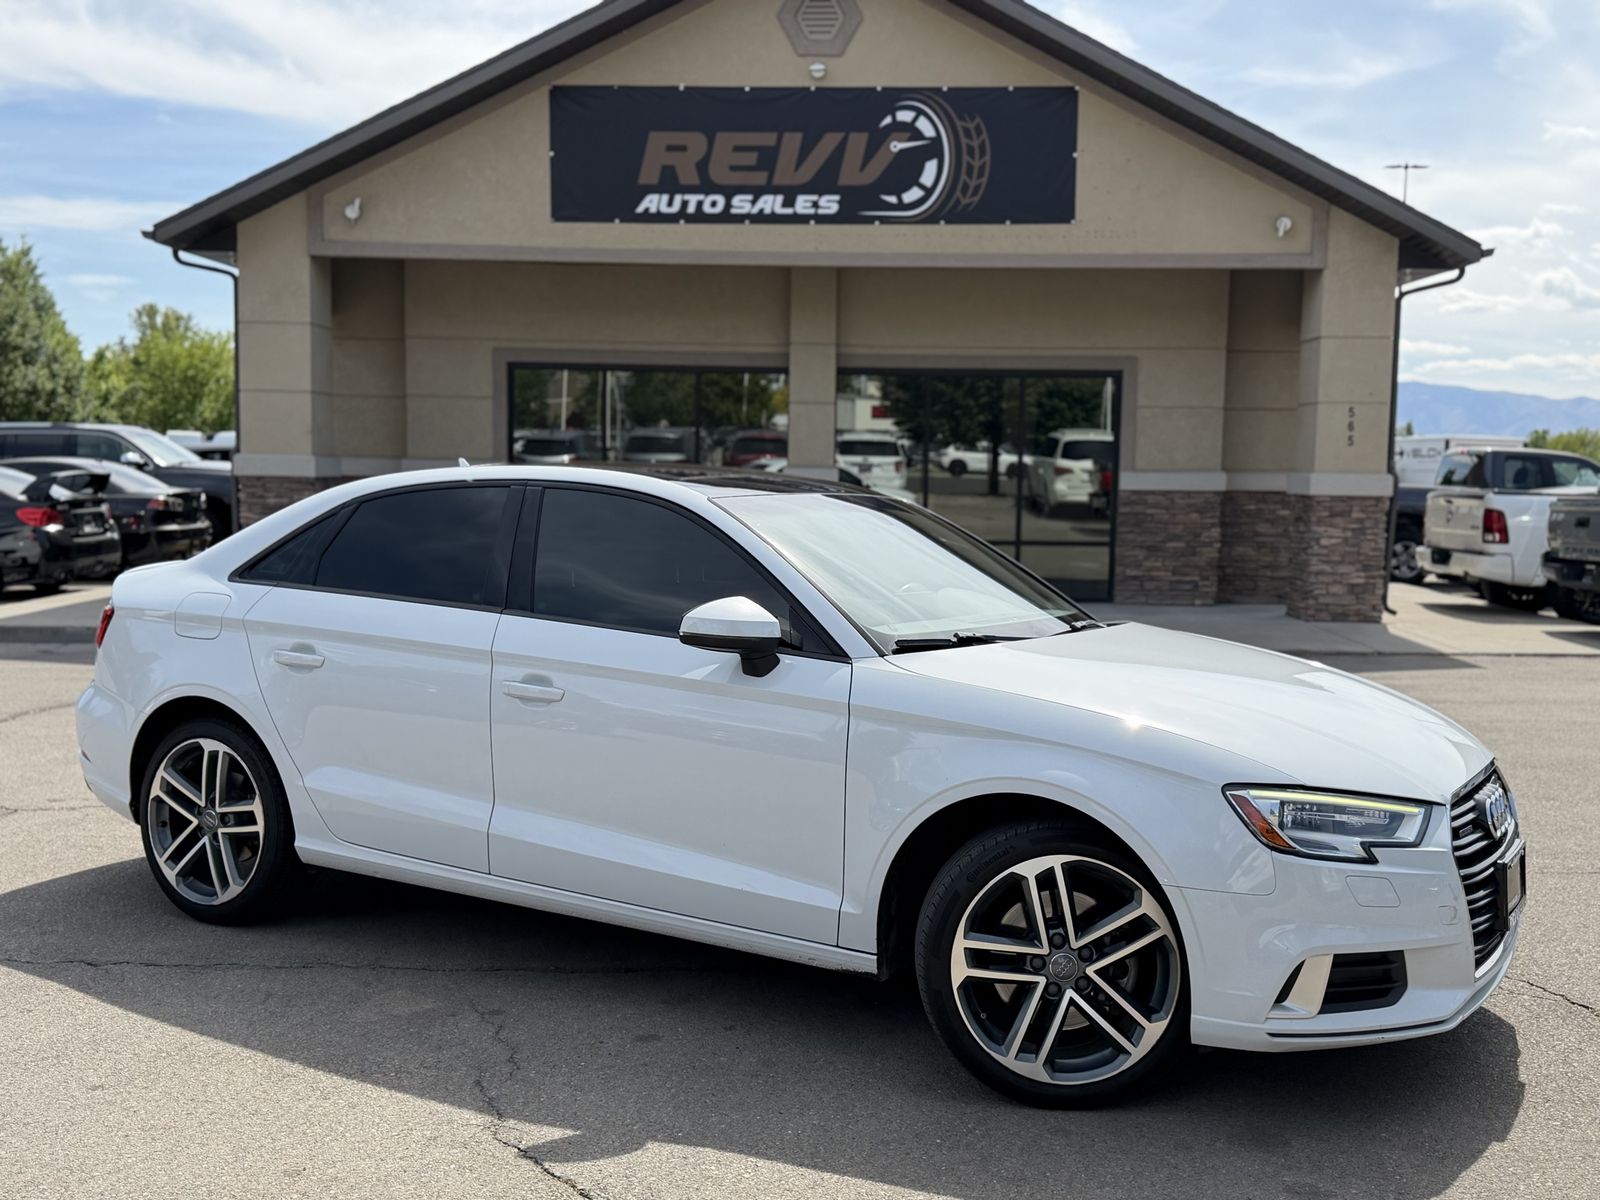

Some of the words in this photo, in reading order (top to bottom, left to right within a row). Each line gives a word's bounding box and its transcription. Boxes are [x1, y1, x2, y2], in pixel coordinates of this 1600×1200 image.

[637, 131, 911, 186] REVV
[634, 193, 726, 214] AUTO
[729, 194, 841, 215] SALES
[1347, 406, 1355, 447] 565
